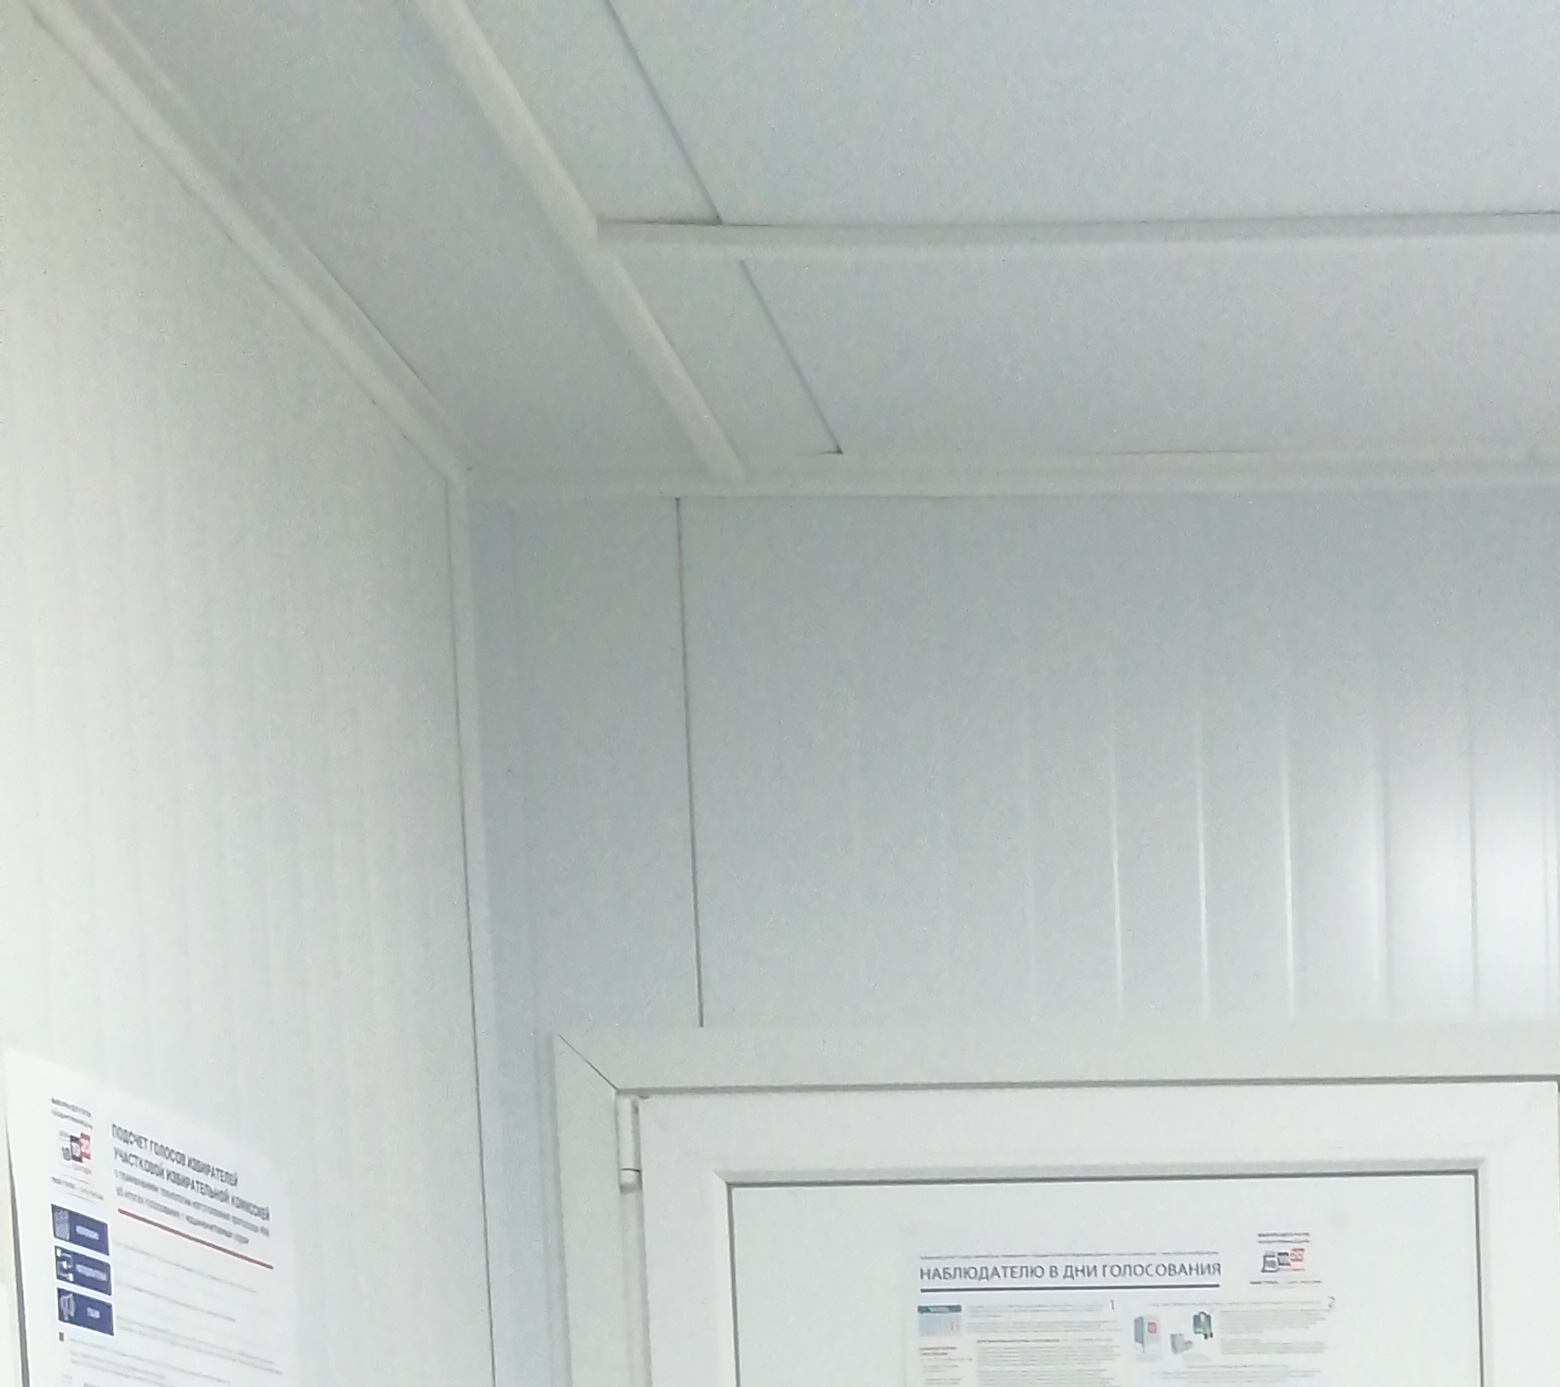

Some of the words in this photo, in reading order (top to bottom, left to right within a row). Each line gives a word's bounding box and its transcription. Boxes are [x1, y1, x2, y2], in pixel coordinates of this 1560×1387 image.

[113, 1146, 165, 1180] УЧАСТКОВОЙ
[150, 1140, 186, 1168] ГОЛОСОВ
[187, 1154, 239, 1188] ИЗБИРАТЕЛЕЙ
[919, 1263, 1046, 1282] НАБЛЮДАТЕЛЮ
[1049, 1264, 1059, 1279] В
[1063, 1262, 1098, 1282] ДНИ
[1102, 1261, 1222, 1279] ГОЛОСОВАНИЯ
